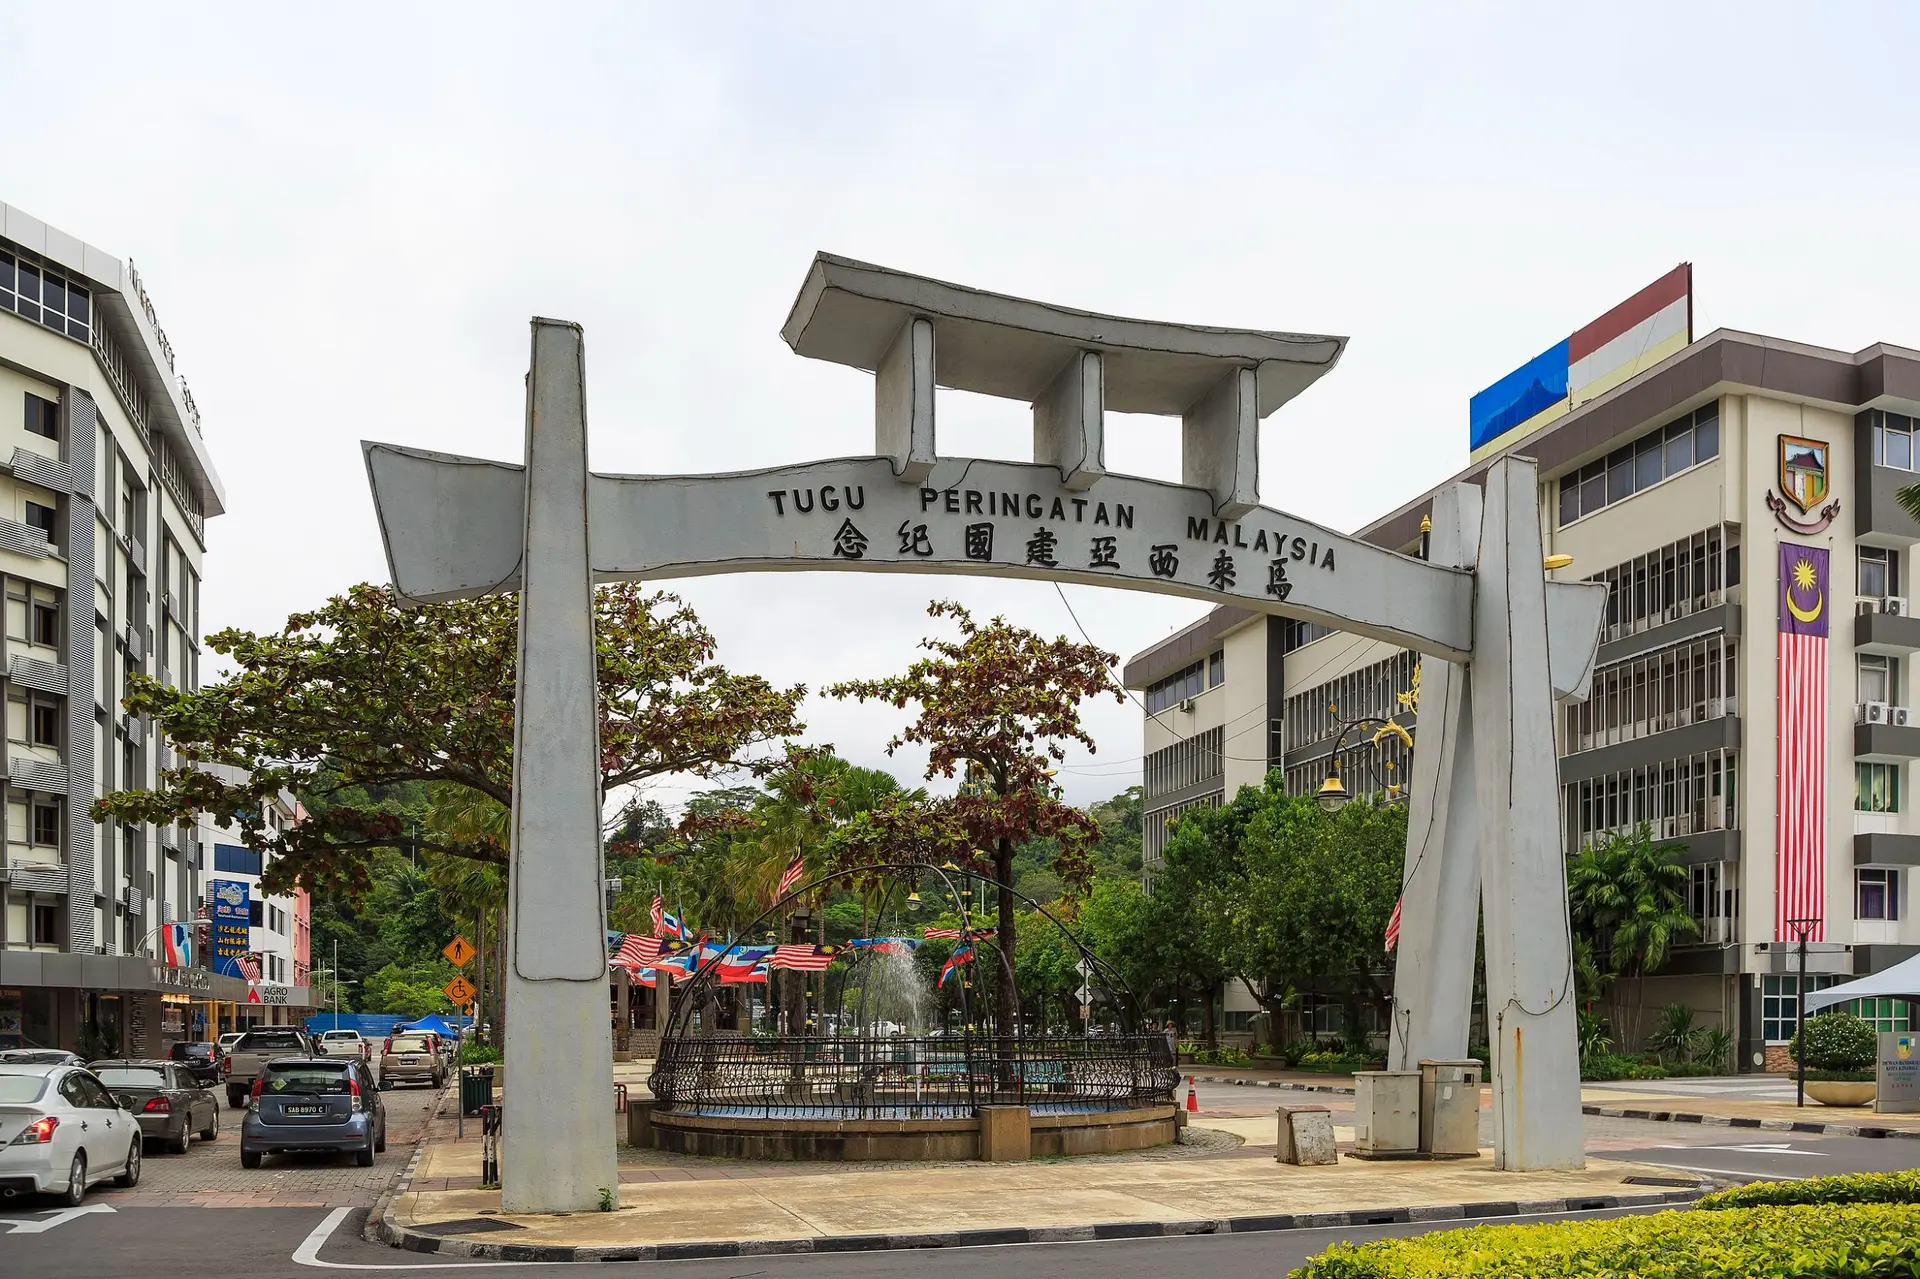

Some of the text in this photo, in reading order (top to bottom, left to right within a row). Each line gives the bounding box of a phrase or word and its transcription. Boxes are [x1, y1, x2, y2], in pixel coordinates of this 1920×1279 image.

[768, 485, 1335, 571] TUGU PERINGATAN MALAYSIA
[263, 987, 288, 996] AGRO
[263, 996, 288, 1004] BANK
